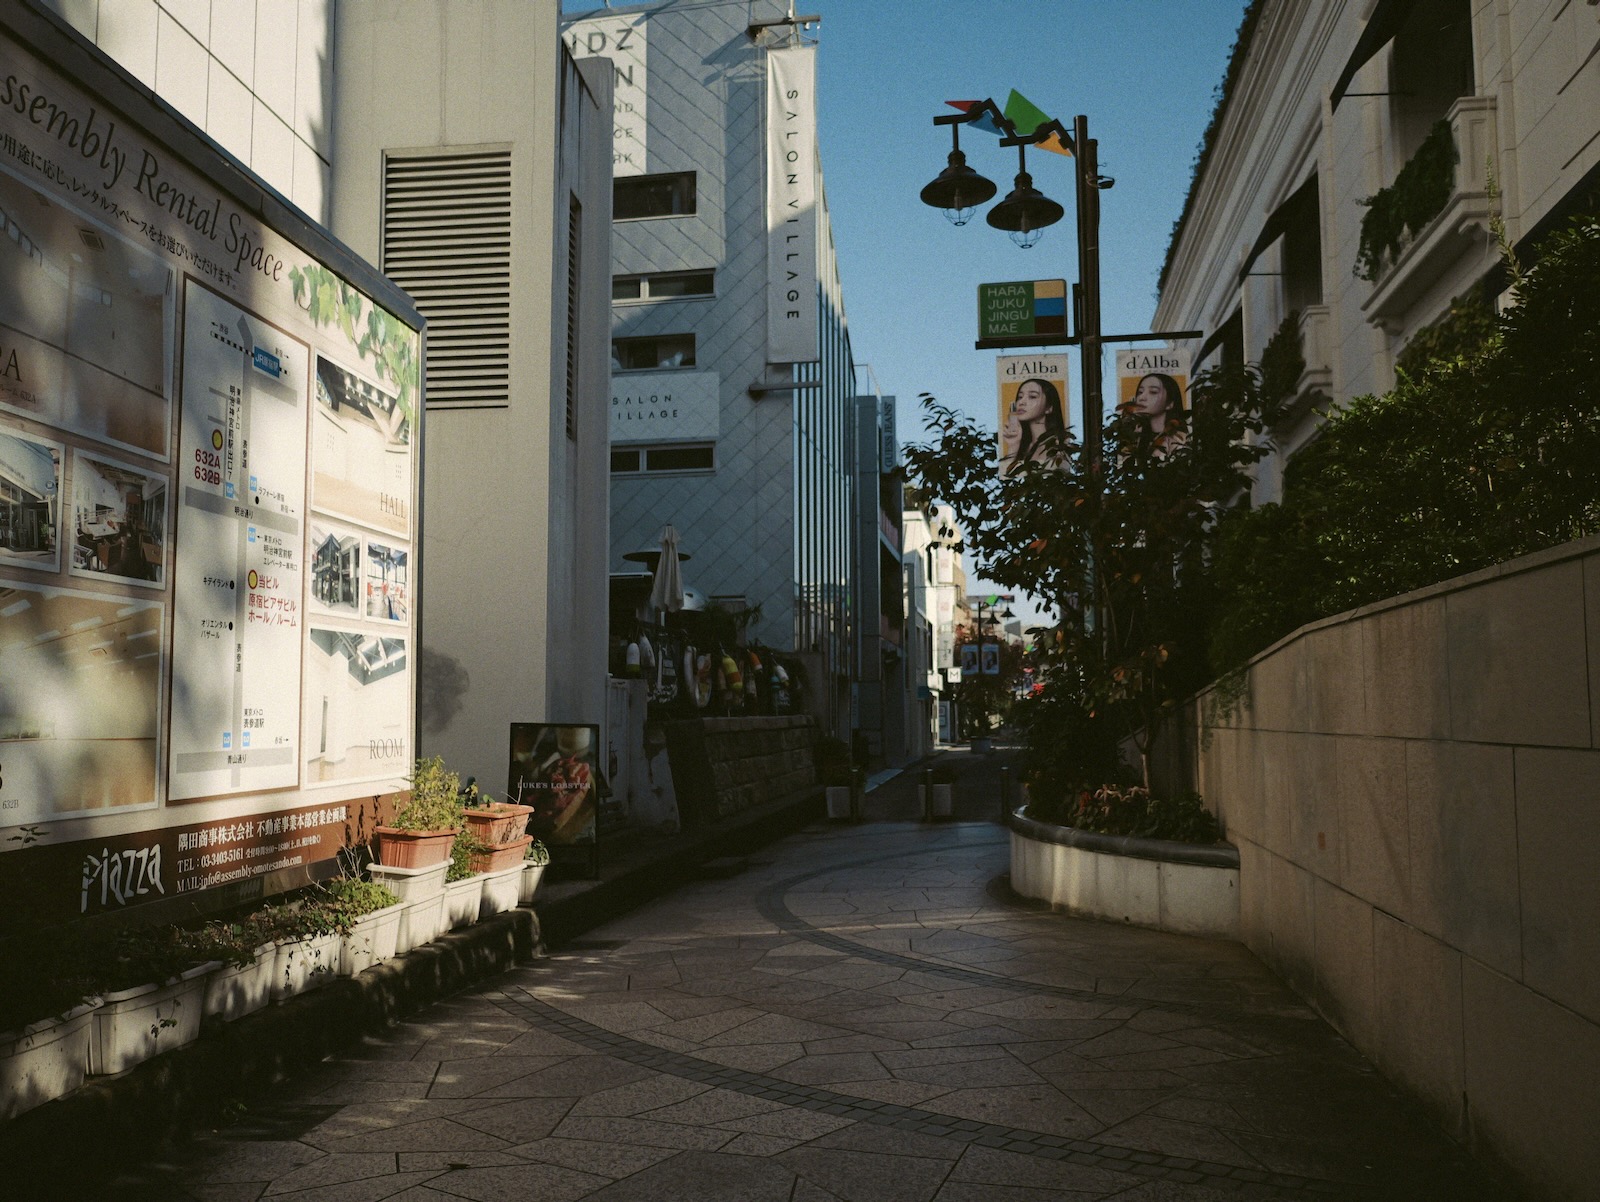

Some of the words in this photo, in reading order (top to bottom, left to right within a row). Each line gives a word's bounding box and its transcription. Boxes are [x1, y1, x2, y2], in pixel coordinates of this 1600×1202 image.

[786, 89, 799, 185] SALON
[0, 75, 126, 190] ssembly
[133, 149, 221, 241] Rental
[224, 212, 283, 282] Space
[0, 133, 237, 291] 用途に応じ、レンタルスペースをお選びいただけます。
[786, 199, 799, 320] VILLAGE
[987, 285, 1027, 298] HARA
[987, 298, 1026, 311] JUKU
[987, 310, 1030, 322] JINGU
[988, 322, 1018, 334] MAE
[0, 346, 22, 382] A
[1006, 361, 1058, 376] d'Alba
[1126, 355, 1180, 370] d'Alba
[612, 394, 672, 406] SALON
[617, 409, 679, 420] ILLAGE
[195, 448, 221, 469] 632A
[883, 434, 894, 468] GUESS
[194, 466, 220, 486] 632B
[380, 492, 406, 519] HALL
[258, 575, 280, 590] 当ビル
[369, 738, 403, 760] ROOM
[551, 782, 591, 790] LOBSTER
[177, 821, 254, 852] 隅田商事株式会社
